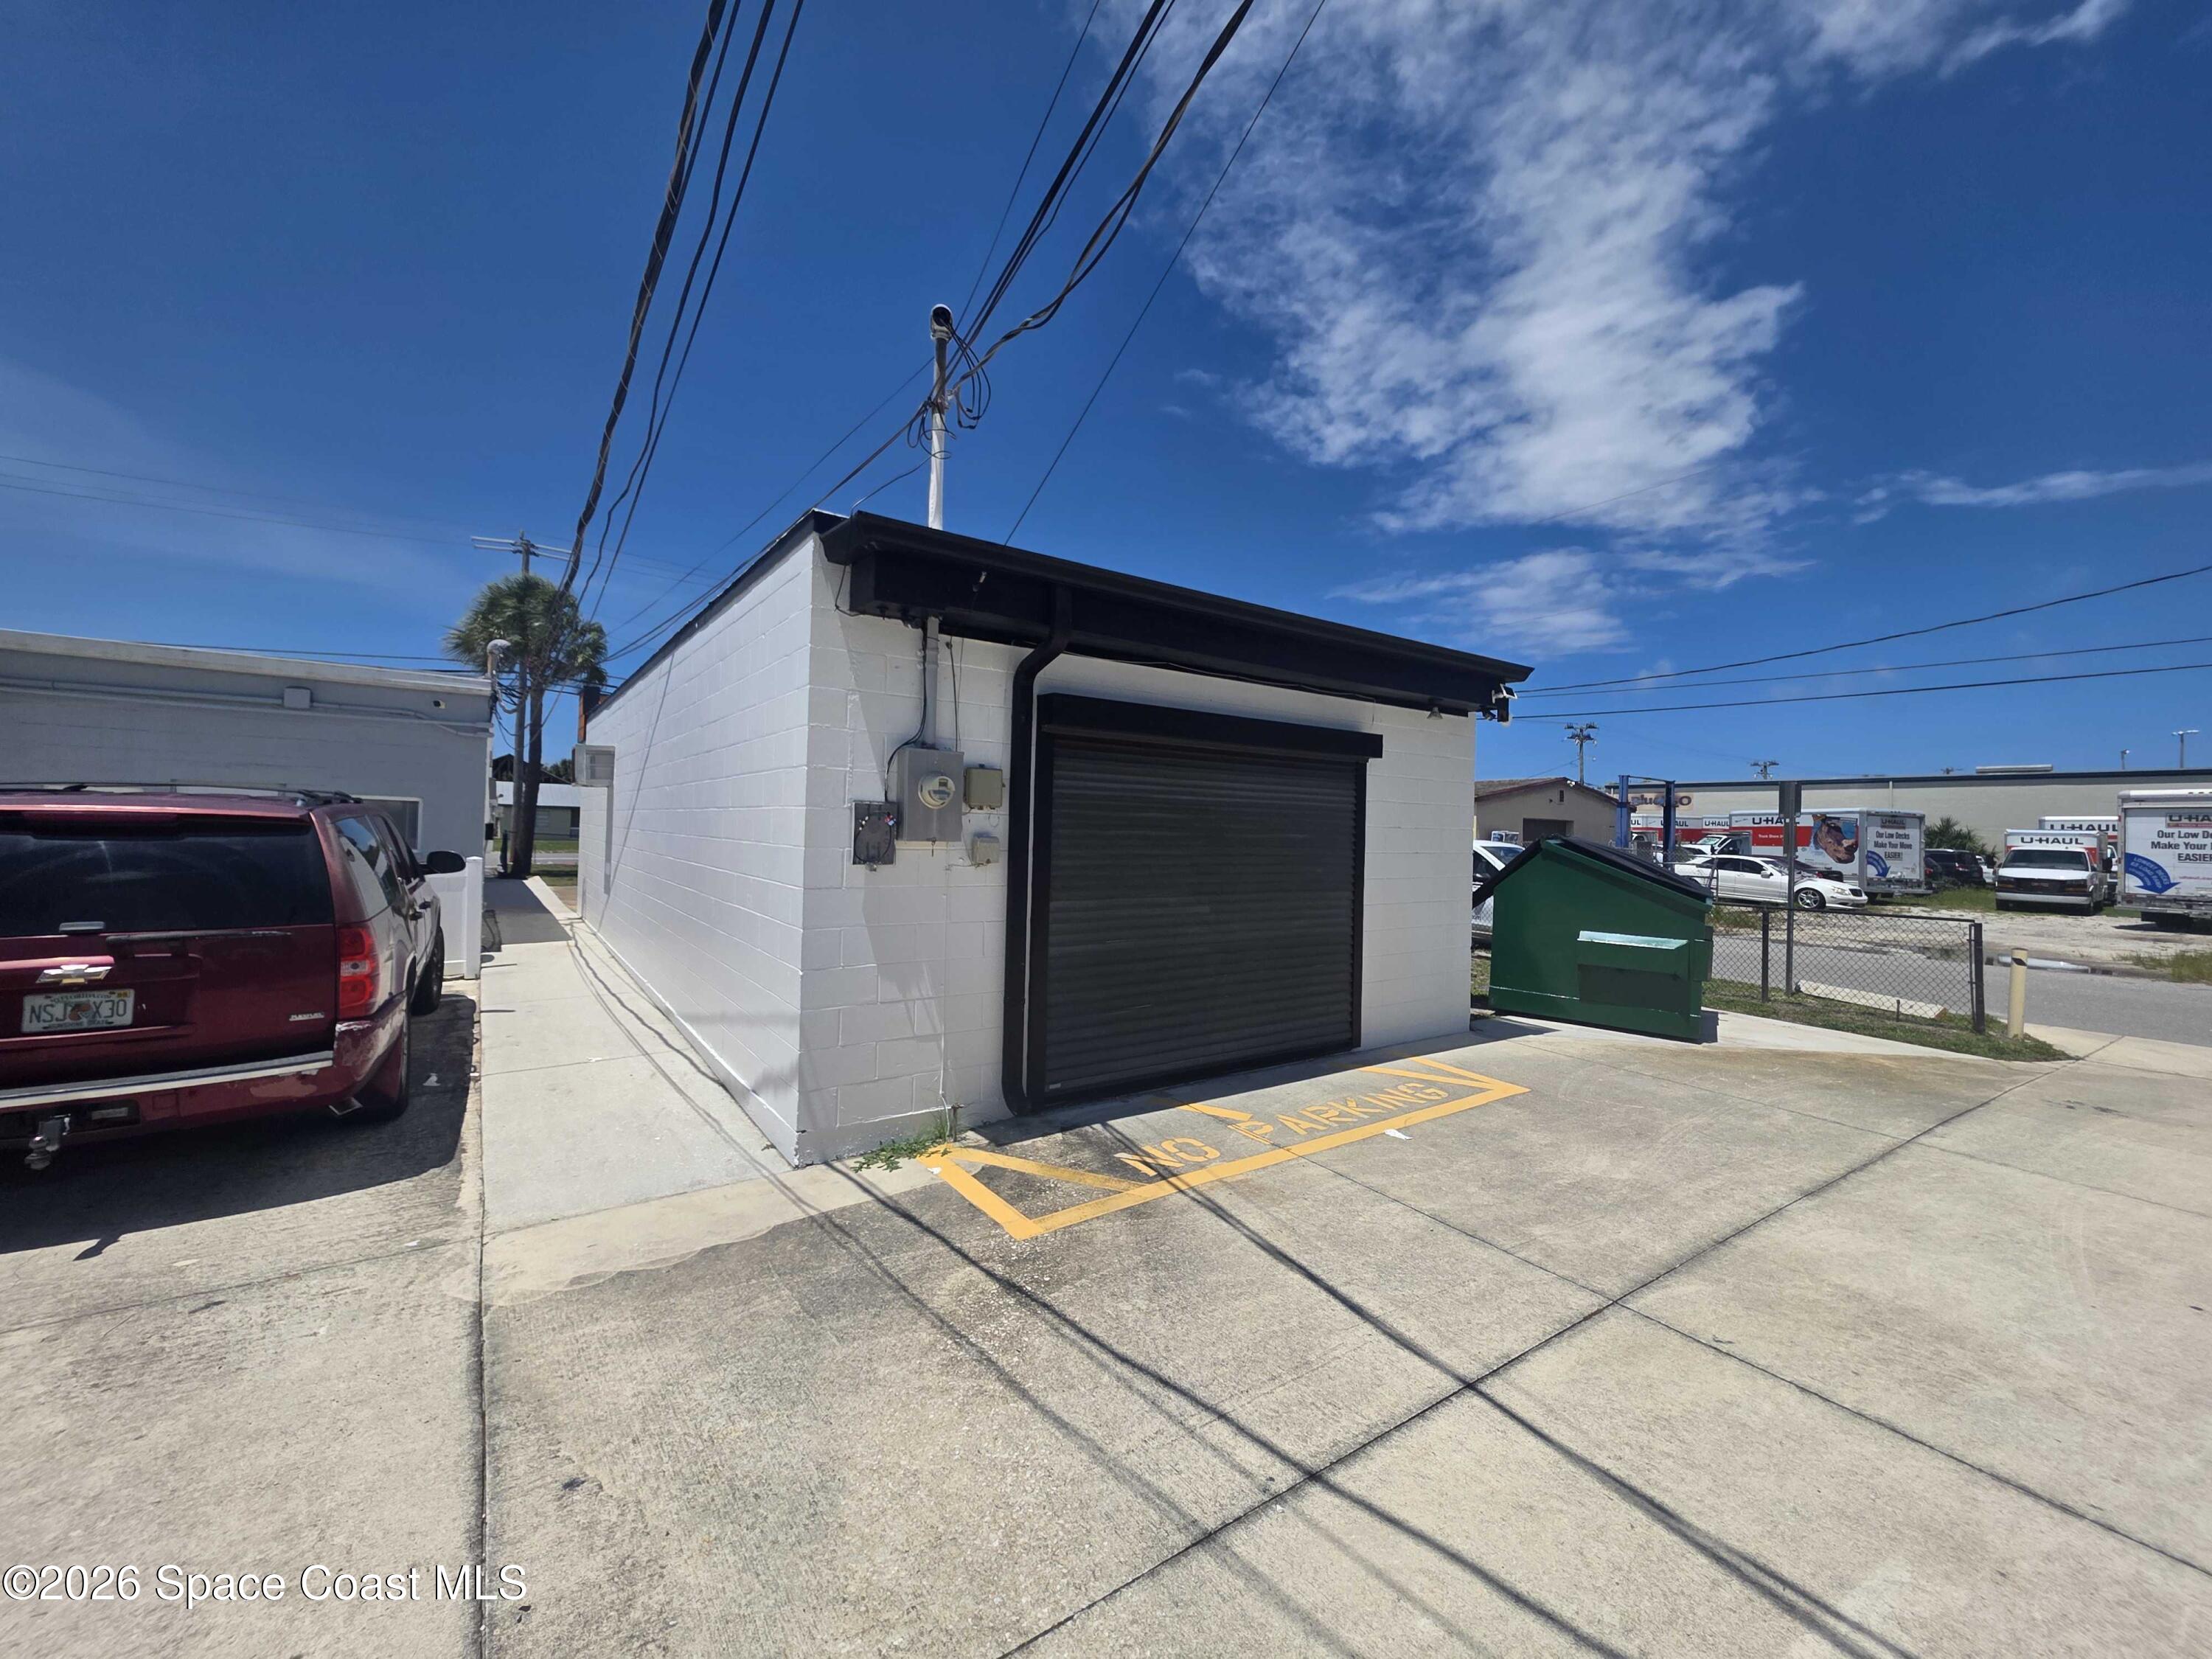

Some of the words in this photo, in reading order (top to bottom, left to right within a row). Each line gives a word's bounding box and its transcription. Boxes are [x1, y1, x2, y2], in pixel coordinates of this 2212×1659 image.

[1752, 816, 1800, 824] U-HA
[1876, 830, 1885, 839] Our
[1885, 831, 1894, 839] Low
[1896, 832, 1910, 840] Decks
[2157, 830, 2174, 838] Our
[1874, 841, 1887, 849] Make
[1899, 841, 1913, 849] Move
[2020, 836, 2084, 845] U-HAUL
[2151, 841, 2180, 849] Make
[2183, 842, 2208, 850] Your
[1113, 1138, 1220, 1177] NO
[1227, 1083, 1449, 1144] PARKING
